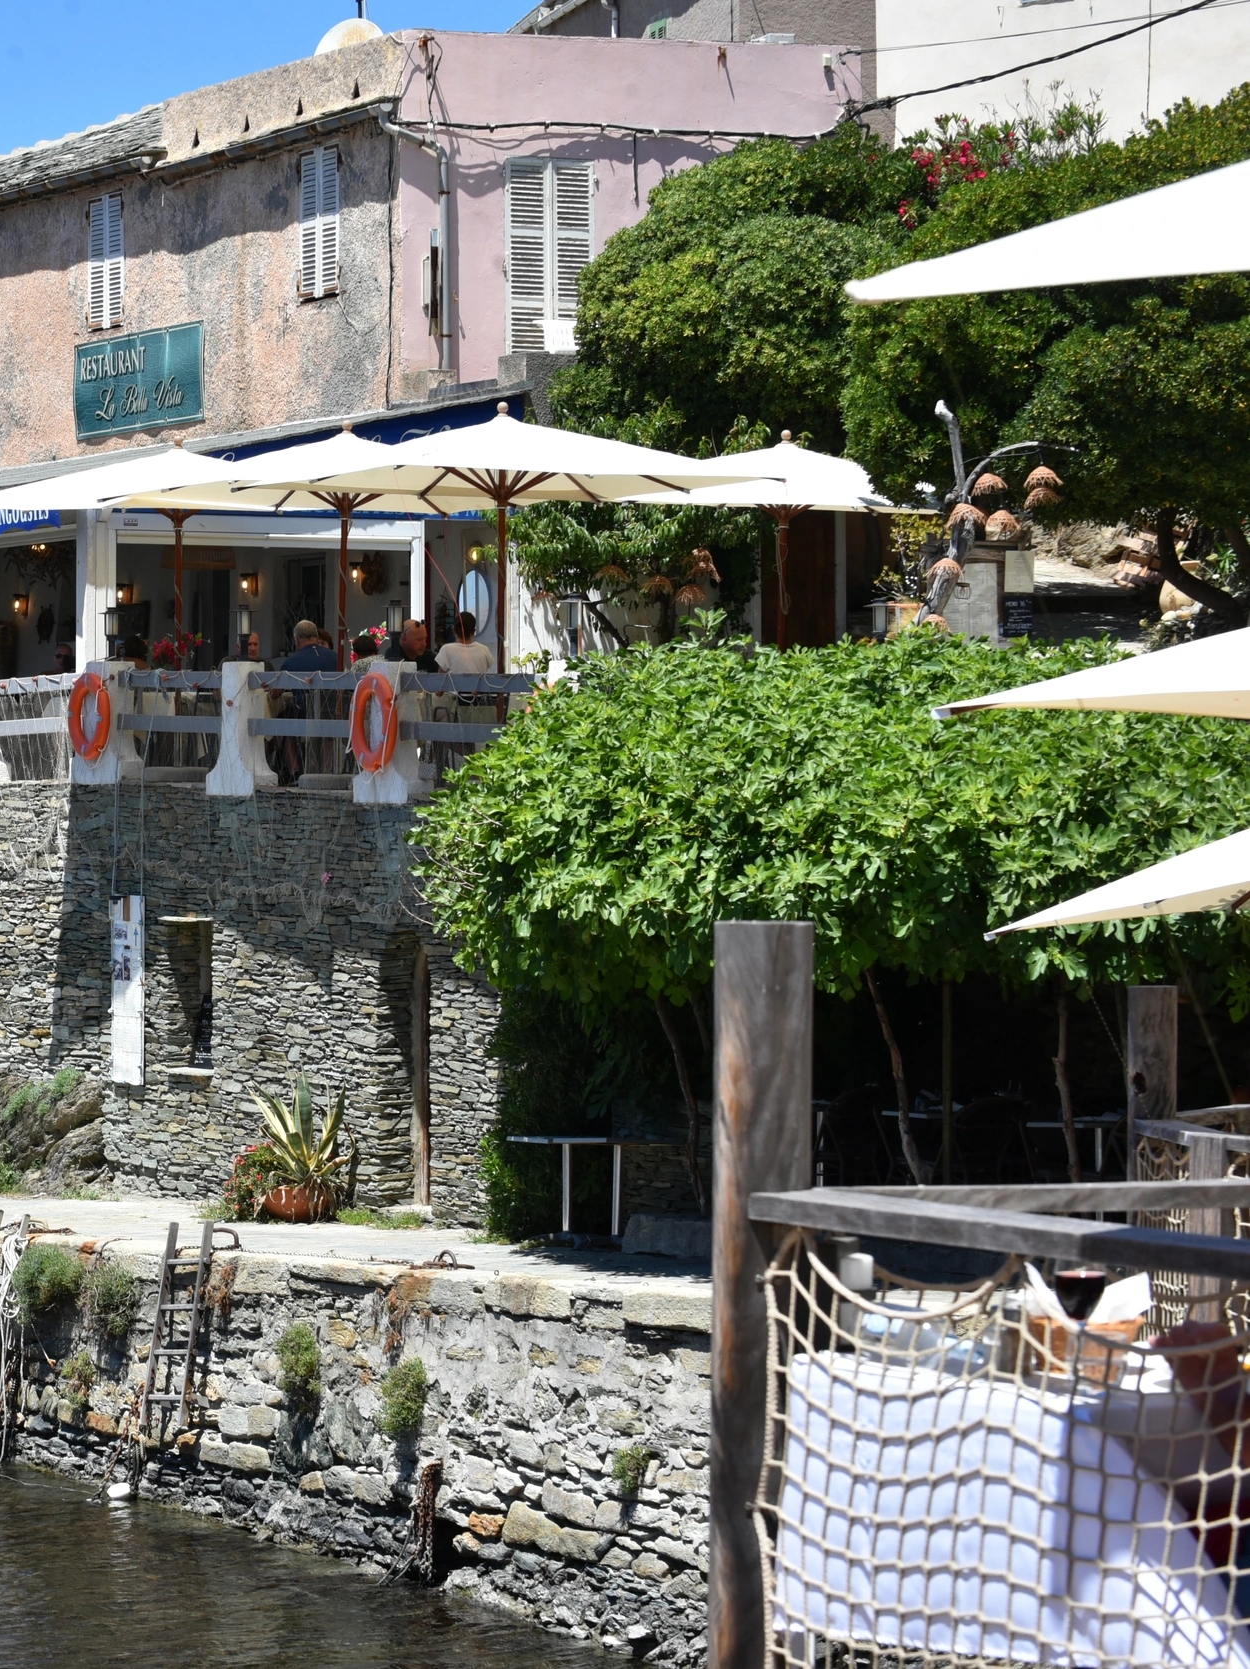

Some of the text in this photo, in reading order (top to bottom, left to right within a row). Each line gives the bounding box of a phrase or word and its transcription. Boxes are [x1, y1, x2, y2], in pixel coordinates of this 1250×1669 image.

[80, 346, 146, 382] RESTAURANT
[94, 376, 183, 421] La Bella Vista
